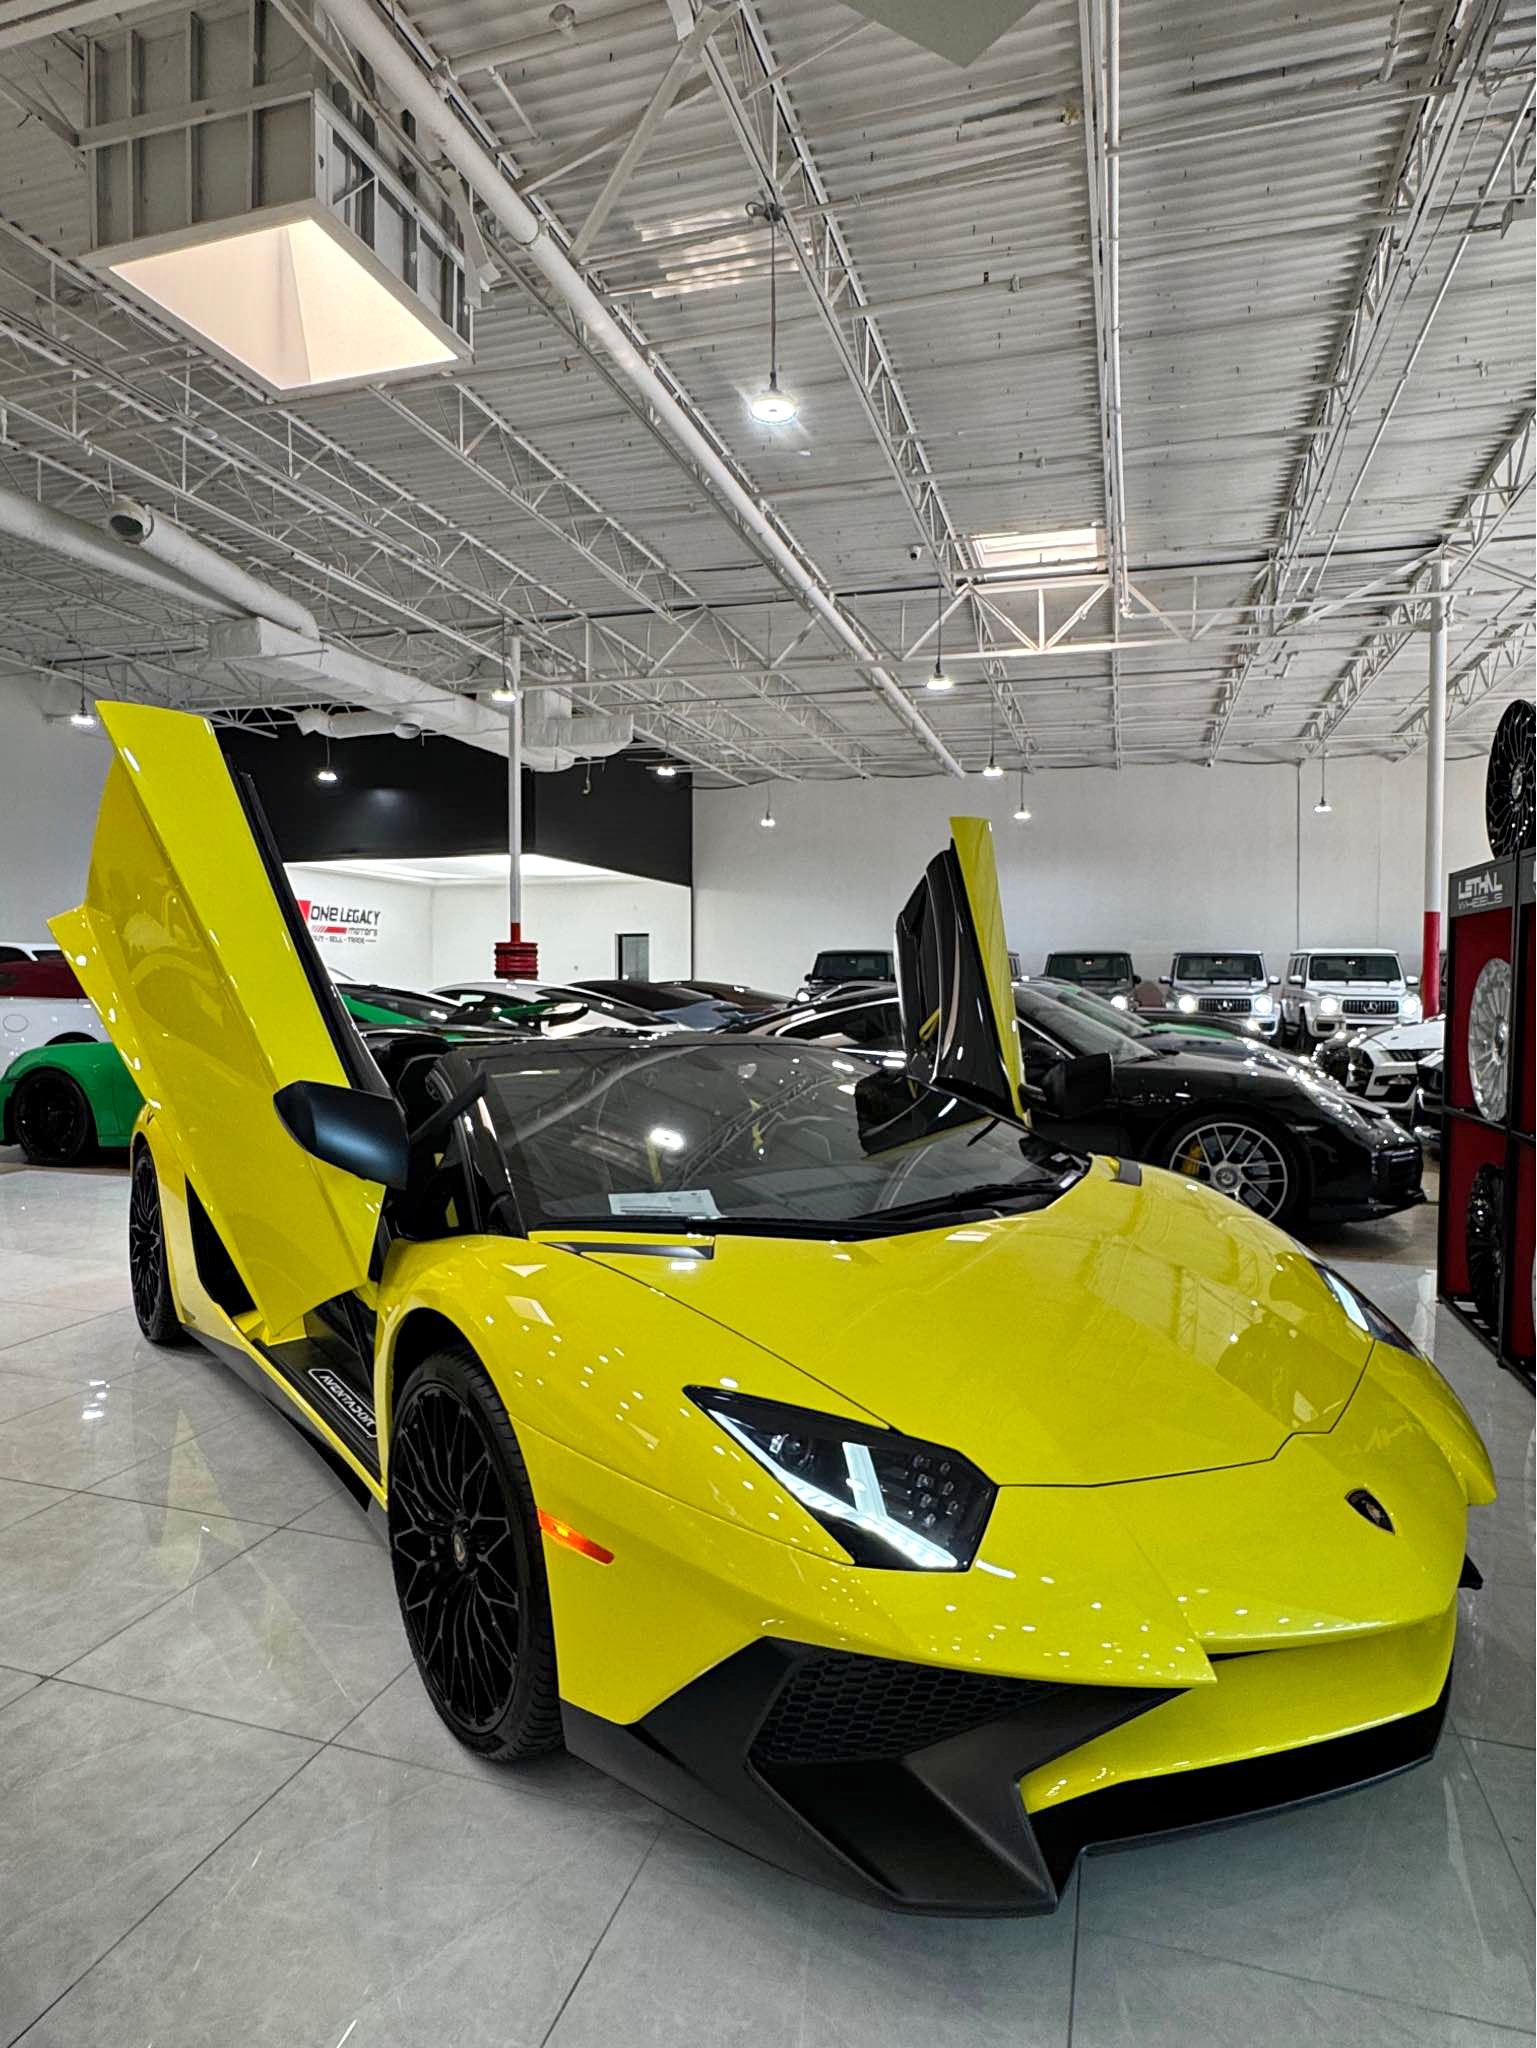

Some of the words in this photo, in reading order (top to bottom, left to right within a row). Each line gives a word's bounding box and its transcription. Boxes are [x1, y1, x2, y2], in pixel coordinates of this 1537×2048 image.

[1458, 870, 1503, 900] LETHAL
[1457, 892, 1503, 910] WHEELS
[341, 908, 380, 925] LEGACY
[319, 1375, 376, 1427] AVENTADOR
